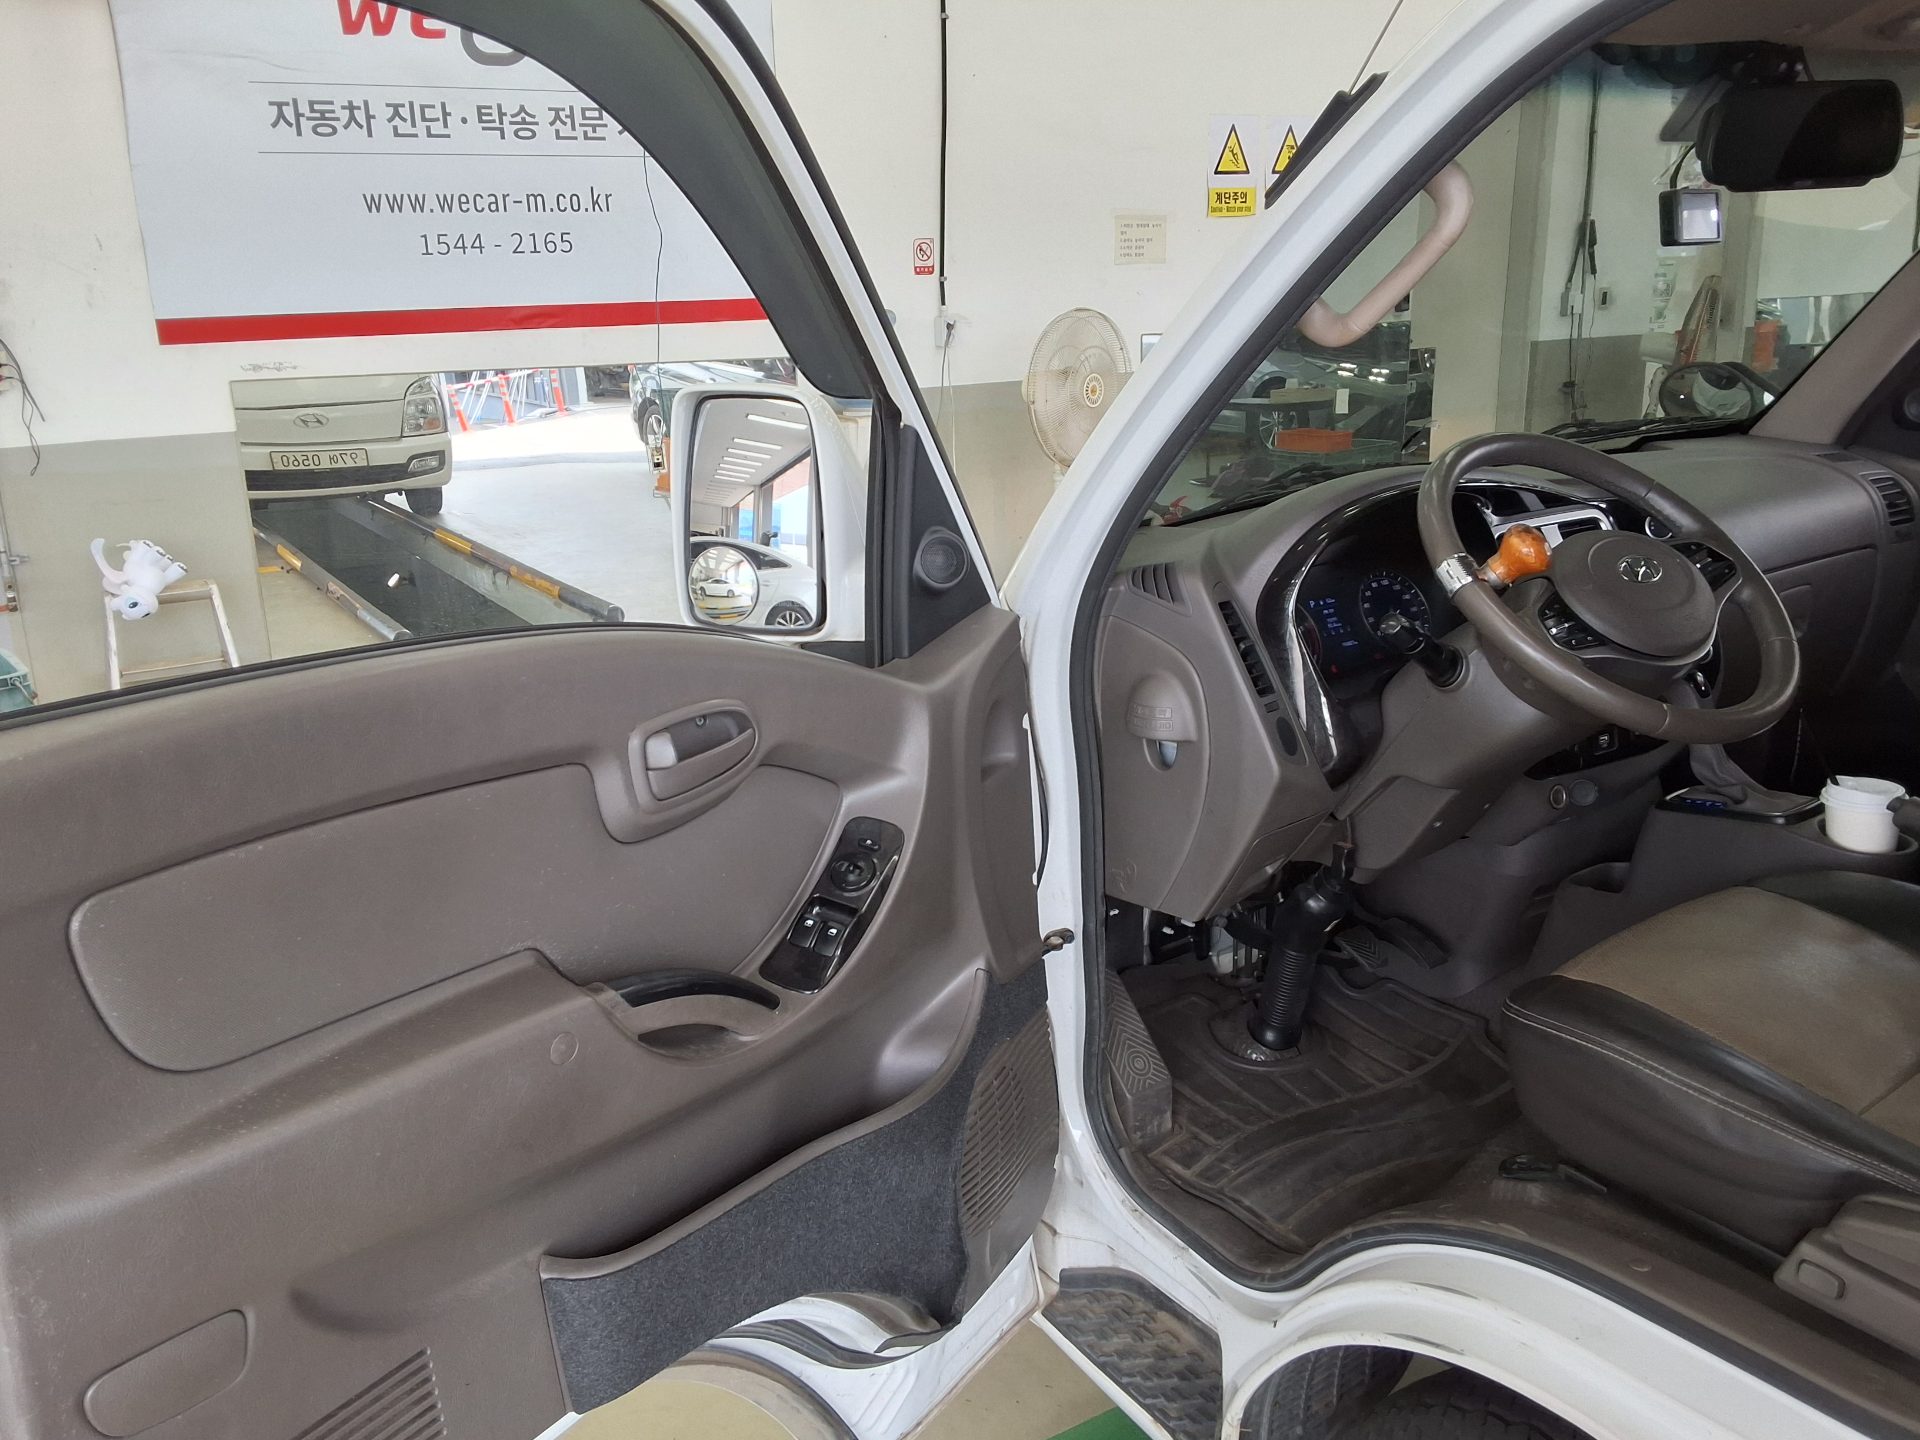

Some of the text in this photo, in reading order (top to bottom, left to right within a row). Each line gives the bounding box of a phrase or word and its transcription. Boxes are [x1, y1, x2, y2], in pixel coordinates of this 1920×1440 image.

[268, 97, 377, 138] 자동차
[547, 104, 608, 141] 전문
[362, 186, 613, 214] www.wecar-m.co.kr
[1215, 191, 1248, 204] 계단주의
